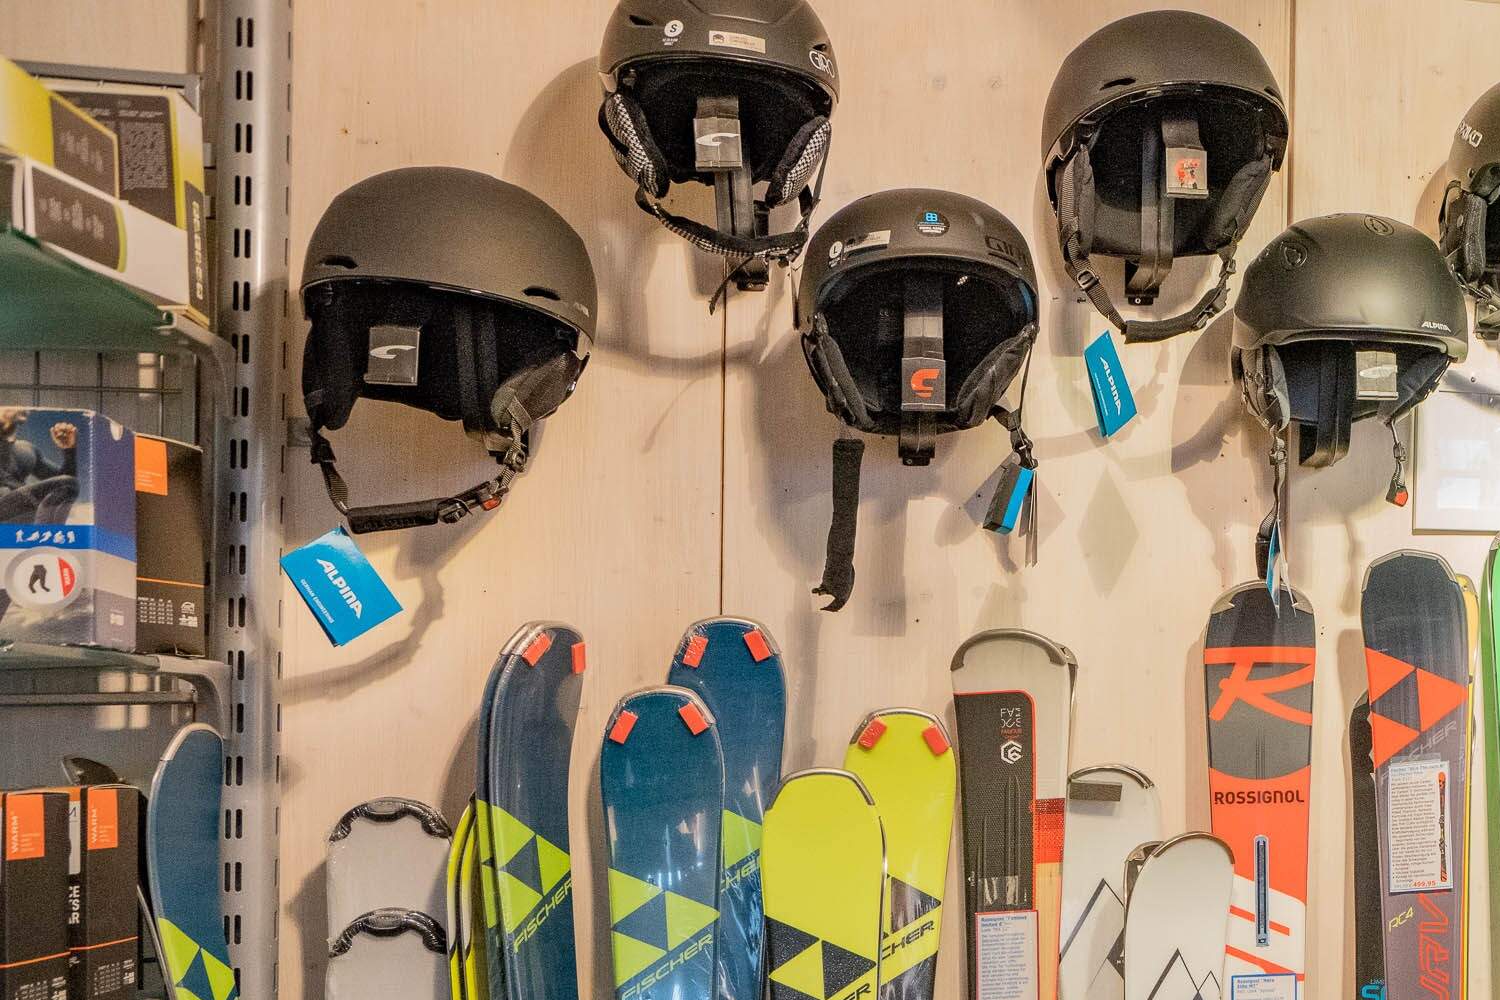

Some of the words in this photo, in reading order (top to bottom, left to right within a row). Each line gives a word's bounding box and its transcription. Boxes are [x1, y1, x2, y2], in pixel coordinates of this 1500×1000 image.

[809, 50, 836, 79] GIRO
[1421, 320, 1452, 333] ALPINA
[1100, 356, 1122, 416] ALPINA
[316, 558, 364, 620] ALPINA
[1214, 789, 1305, 805] ROSSIGNOL
[513, 877, 572, 954] FISCHER
[1388, 906, 1415, 933] RC4
[881, 920, 935, 961] CHER
